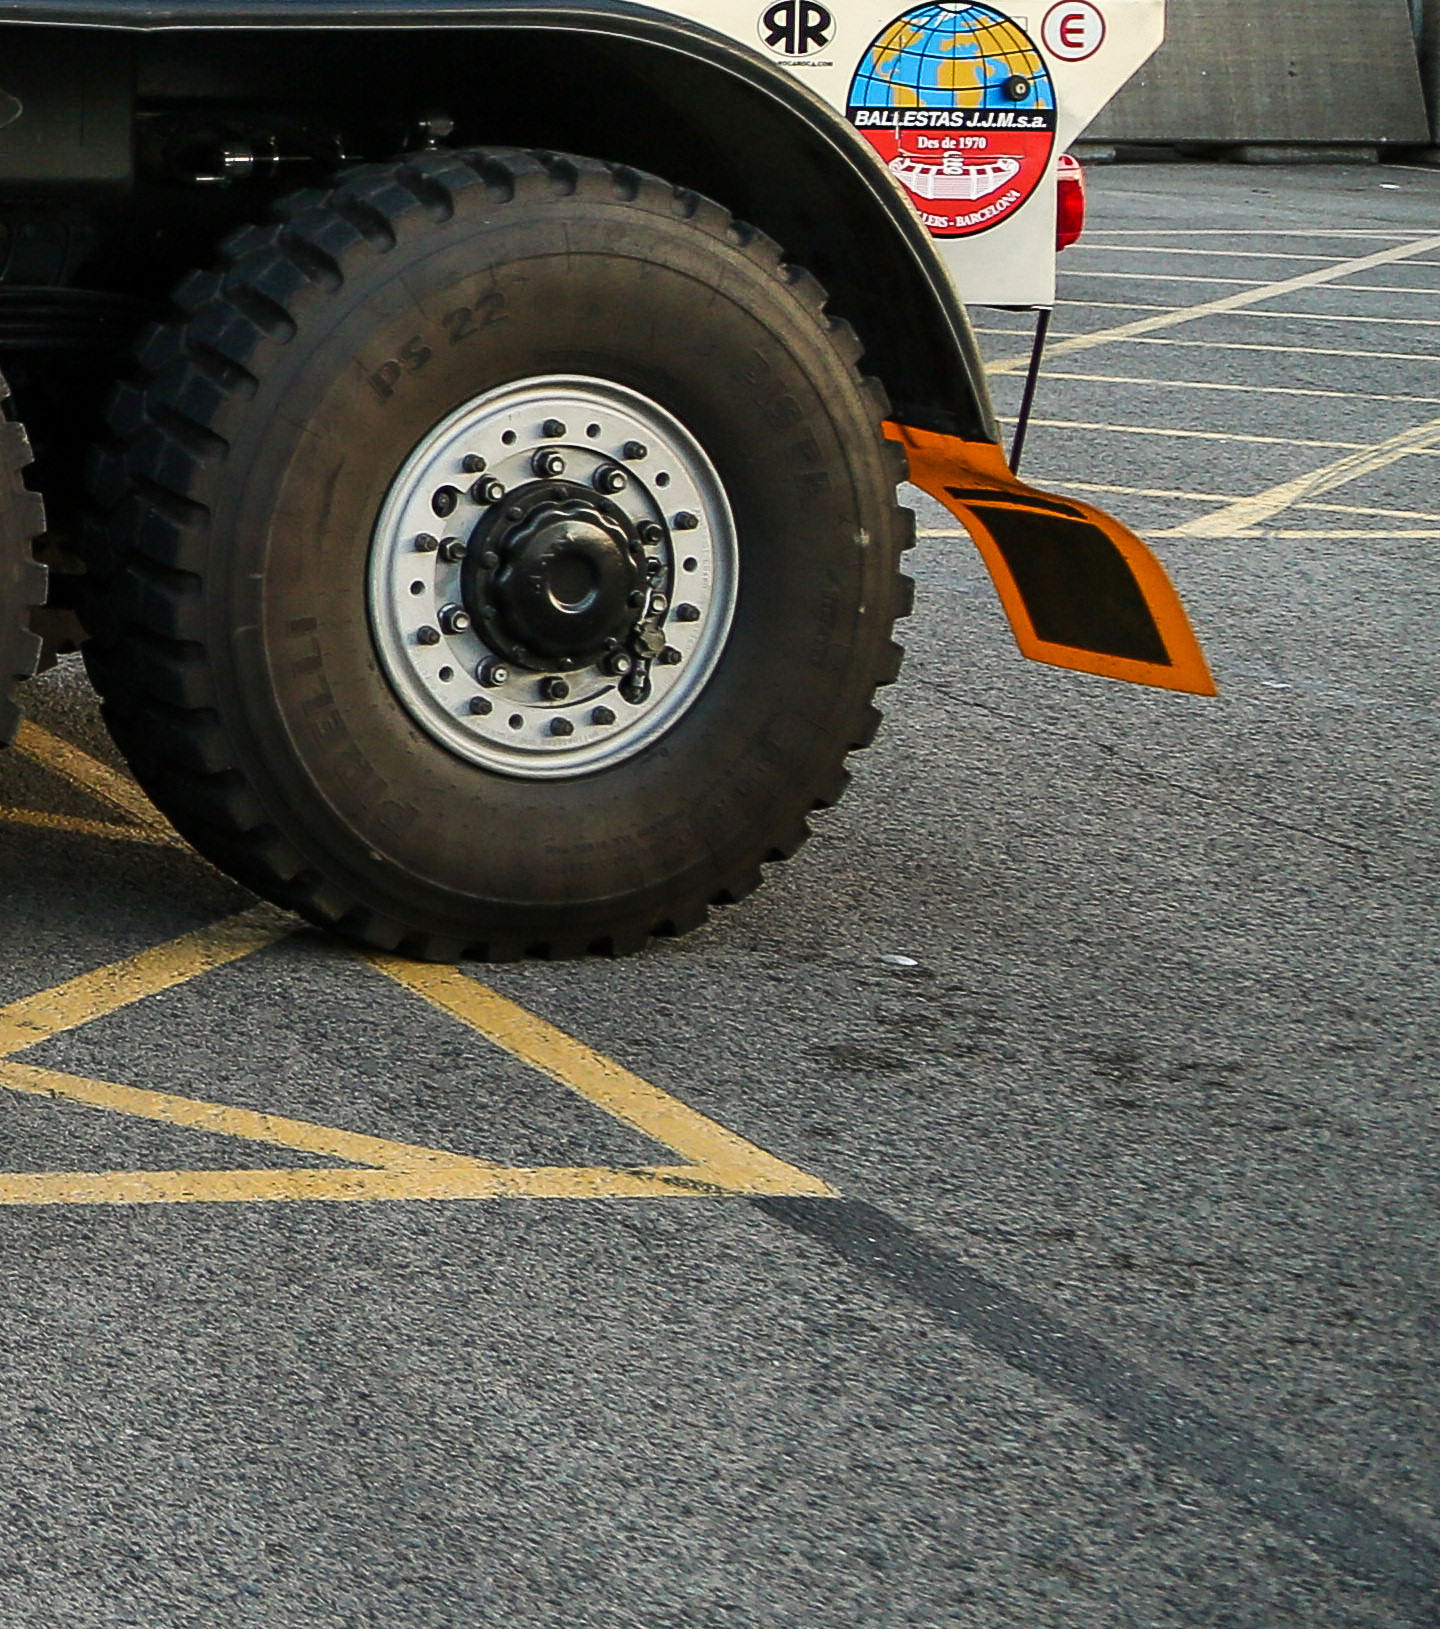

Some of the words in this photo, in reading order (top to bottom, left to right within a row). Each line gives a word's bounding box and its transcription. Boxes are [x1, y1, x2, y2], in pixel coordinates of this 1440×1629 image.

[855, 110, 964, 128] BALLESTAS
[917, 135, 940, 150] Des
[942, 136, 957, 150] de
[959, 136, 988, 151] 1970
[955, 189, 1022, 228] BARCELONA
